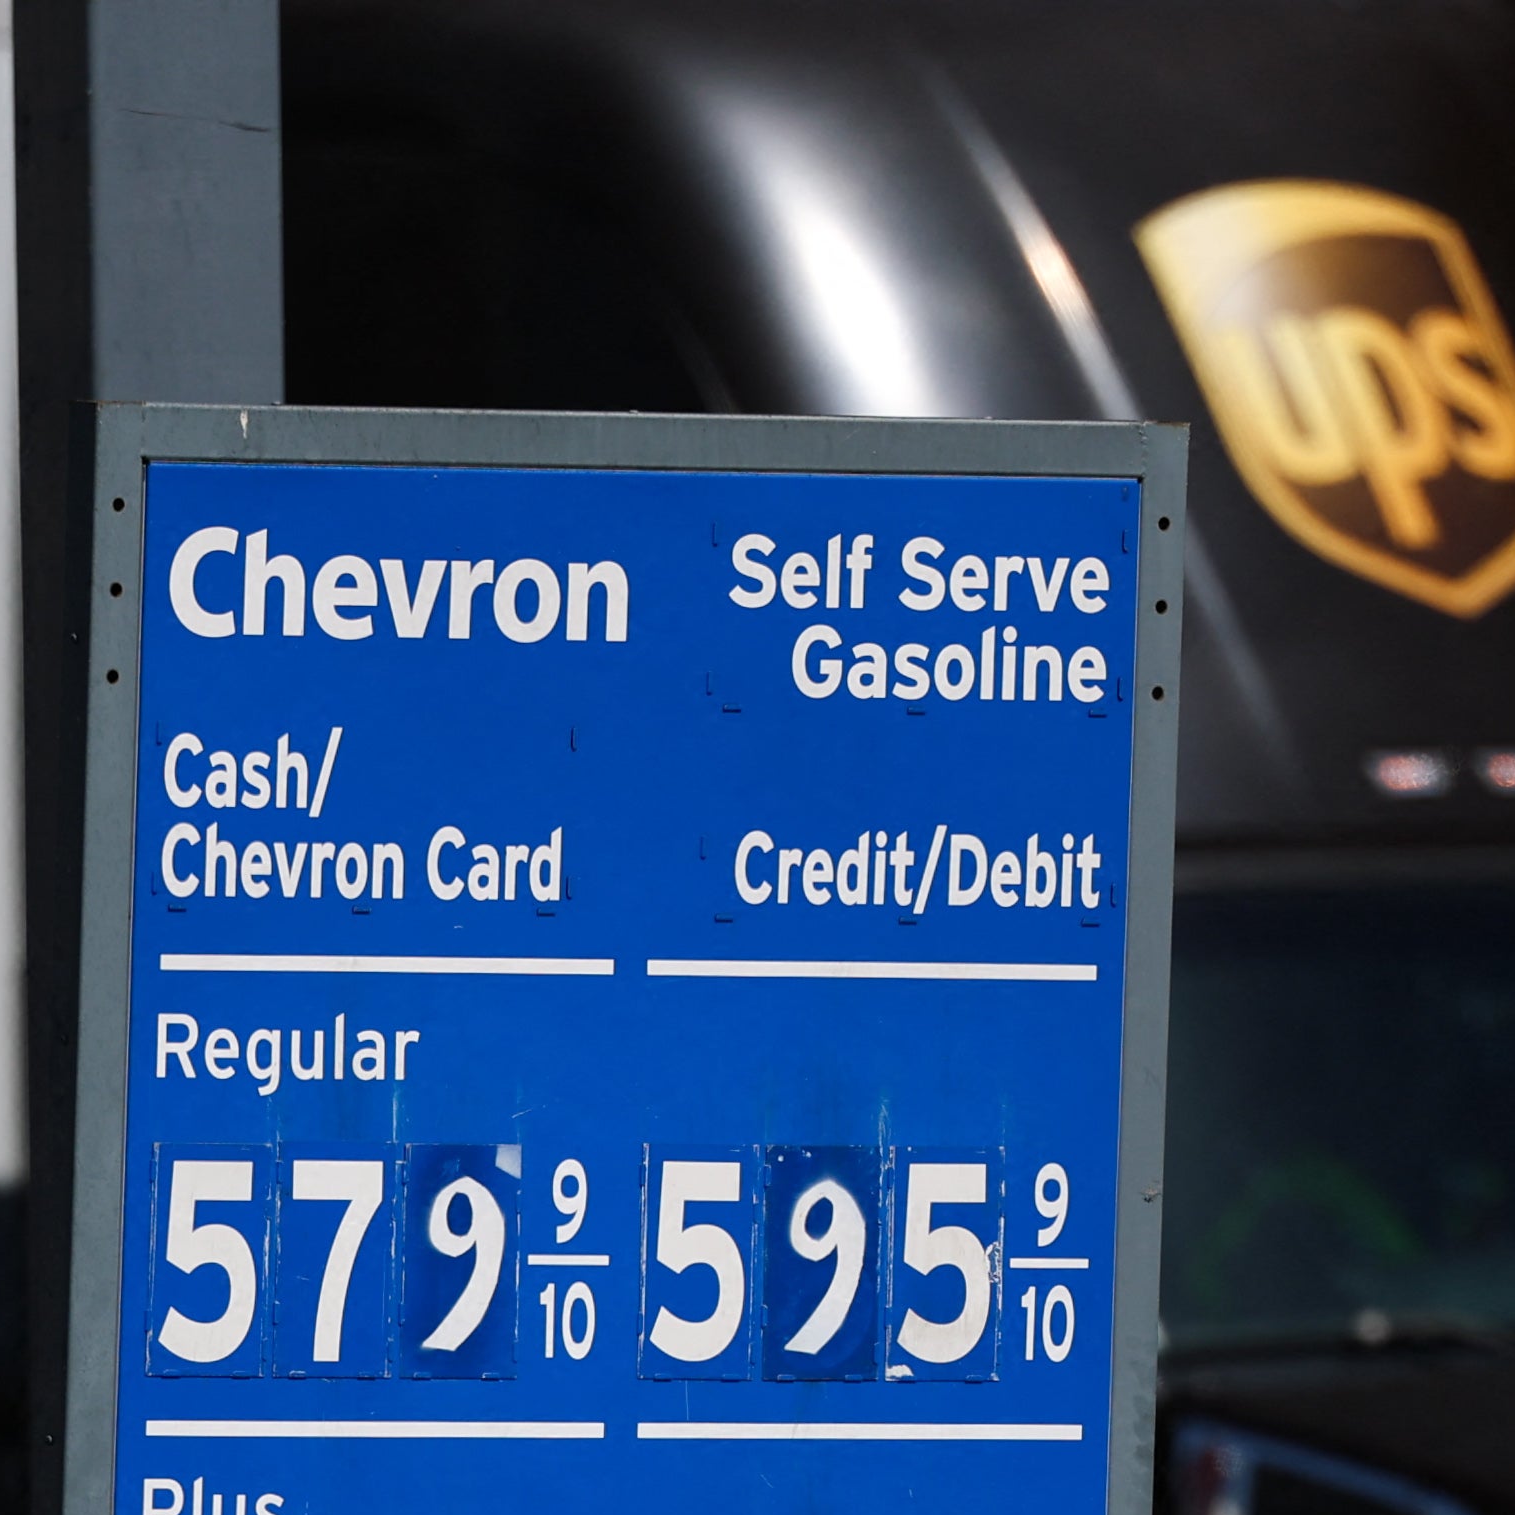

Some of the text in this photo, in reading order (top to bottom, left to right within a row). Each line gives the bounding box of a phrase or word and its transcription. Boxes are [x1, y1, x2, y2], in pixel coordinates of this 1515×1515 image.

[167, 524, 631, 645] Chevron
[727, 531, 1112, 615] Self Serve
[790, 623, 1109, 704] Gasoline
[162, 726, 345, 819] Cash/
[159, 821, 564, 904] Chevron Card
[732, 823, 1103, 916] Credit/Debit
[155, 1011, 422, 1098] Regular
[156, 1158, 507, 1364] 579
[647, 1159, 995, 1365] 595
